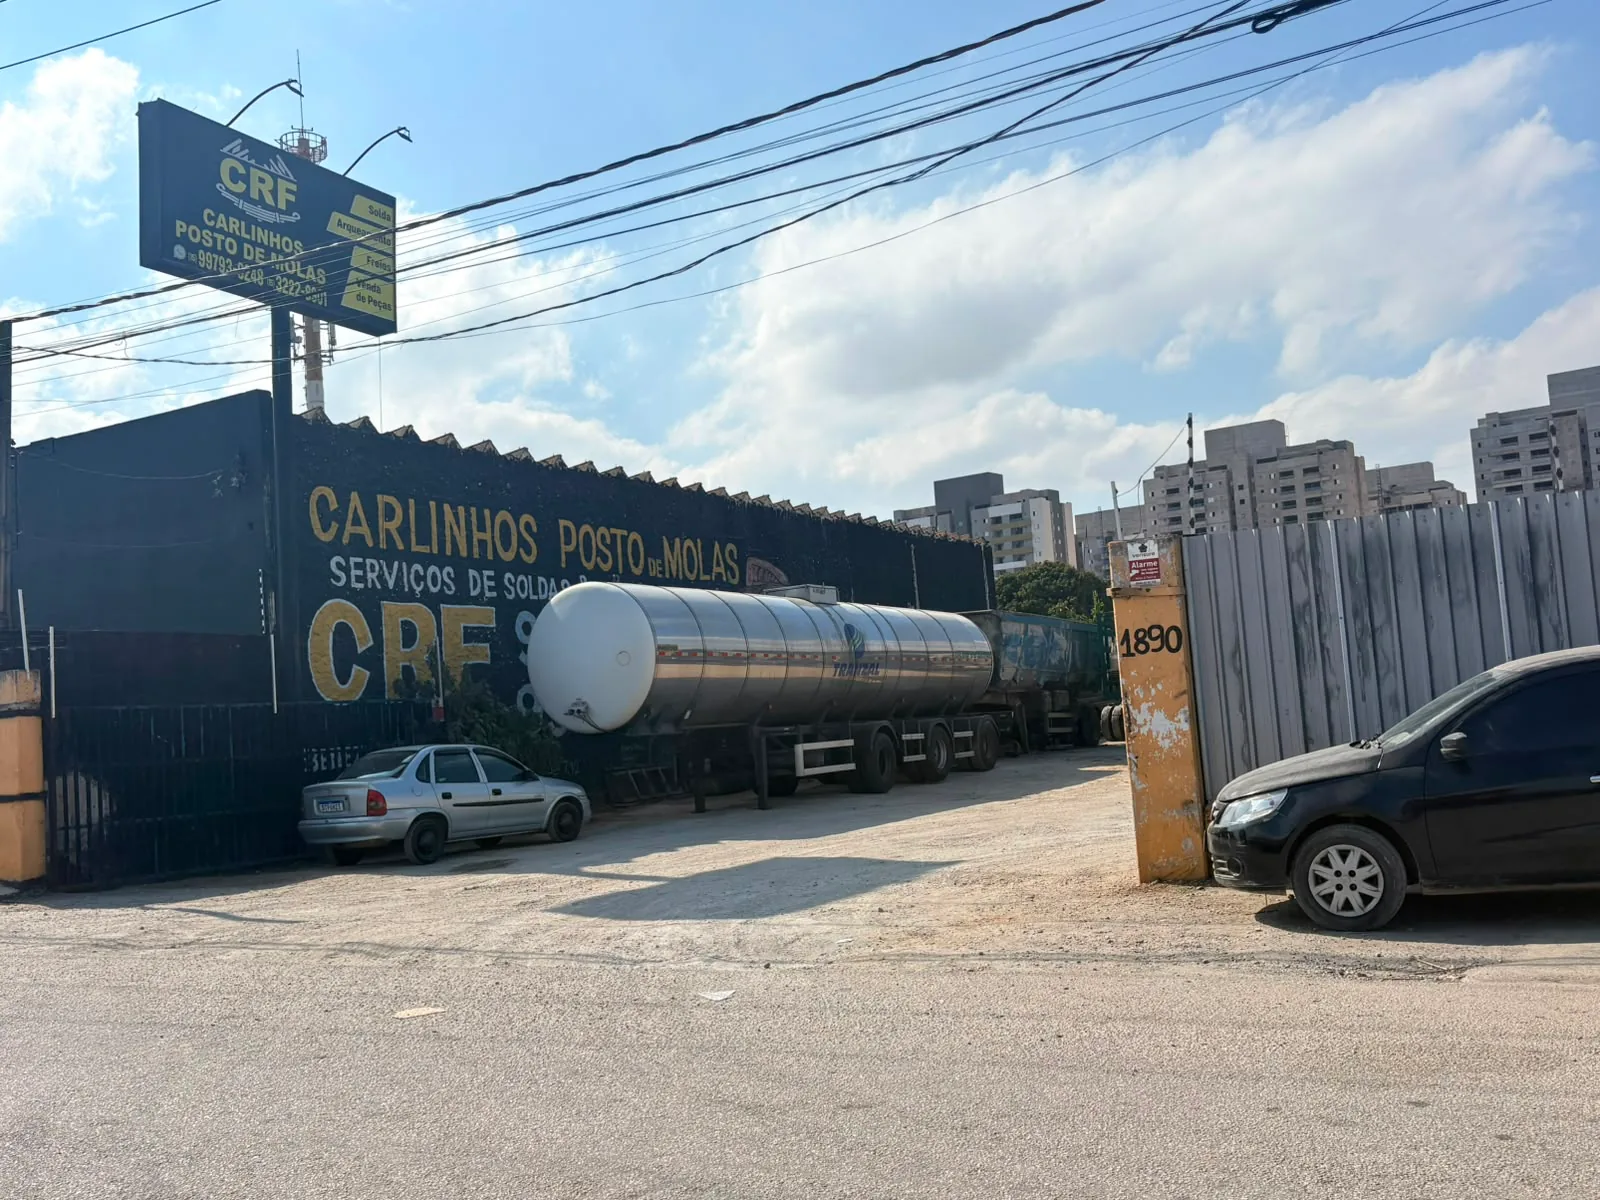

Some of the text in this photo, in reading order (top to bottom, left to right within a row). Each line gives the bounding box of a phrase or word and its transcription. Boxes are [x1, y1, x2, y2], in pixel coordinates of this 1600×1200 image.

[220, 157, 298, 211] CRF
[202, 208, 304, 253] CARLINHOS
[368, 204, 392, 222] Solda
[175, 219, 326, 285] POSTO DE MOLAS
[366, 255, 392, 273] Freios
[355, 277, 382, 295] Venda
[355, 291, 393, 312] de Peças
[309, 486, 740, 585] CARLINHOS POSTO DE MOLAS
[329, 555, 457, 598] SERVIÇOS
[468, 568, 498, 598] DE
[1131, 560, 1159, 569] Alarme
[308, 598, 496, 703] CRF
[1119, 624, 1184, 658] 1890
